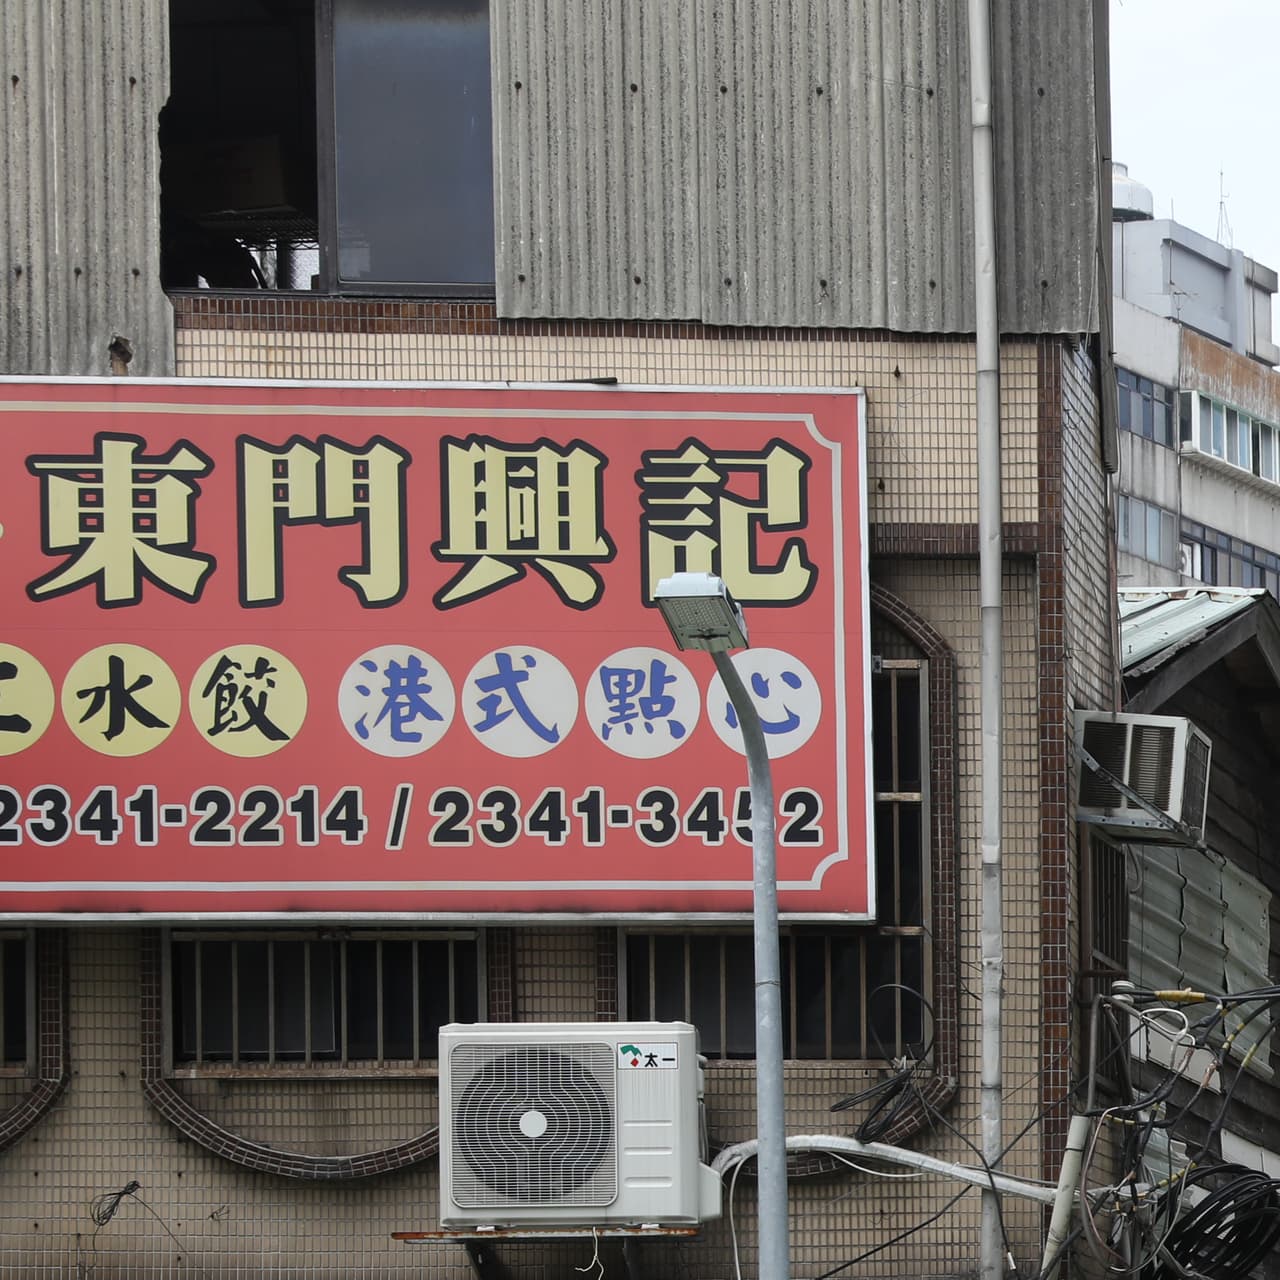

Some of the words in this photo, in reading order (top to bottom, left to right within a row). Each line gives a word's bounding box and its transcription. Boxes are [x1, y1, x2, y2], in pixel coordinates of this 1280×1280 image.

[25, 431, 819, 609] 東門興記
[354, 652, 802, 744] 港式點心
[645, 1053, 675, 1067] 太一
